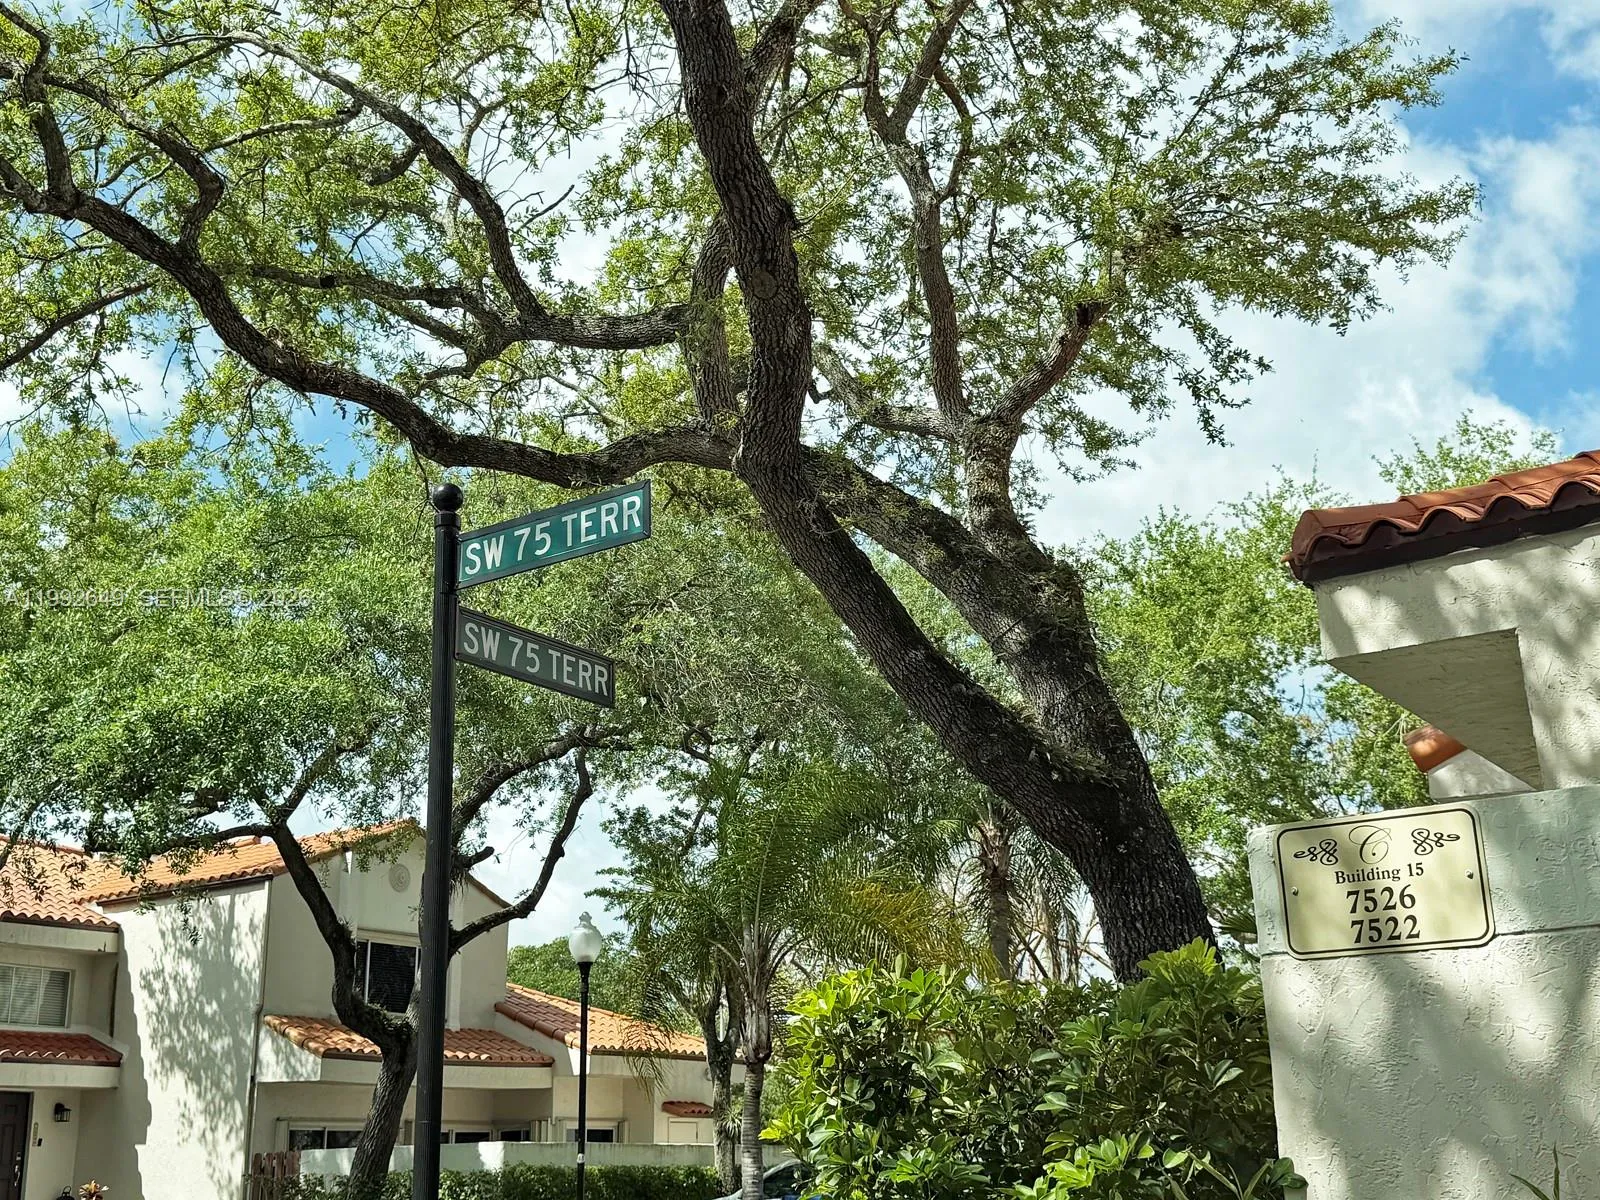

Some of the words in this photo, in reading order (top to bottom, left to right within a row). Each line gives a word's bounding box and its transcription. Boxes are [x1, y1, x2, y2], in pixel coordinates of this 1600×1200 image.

[465, 535, 505, 575] SW
[514, 522, 551, 562] 75
[562, 495, 641, 547] TERR
[463, 622, 500, 661] SW
[508, 636, 540, 673] 75
[548, 649, 608, 696] TERR
[1334, 867, 1401, 885] Building
[1407, 862, 1424, 877] 15
[1346, 884, 1417, 914] 7526
[1350, 914, 1421, 944] 7522
